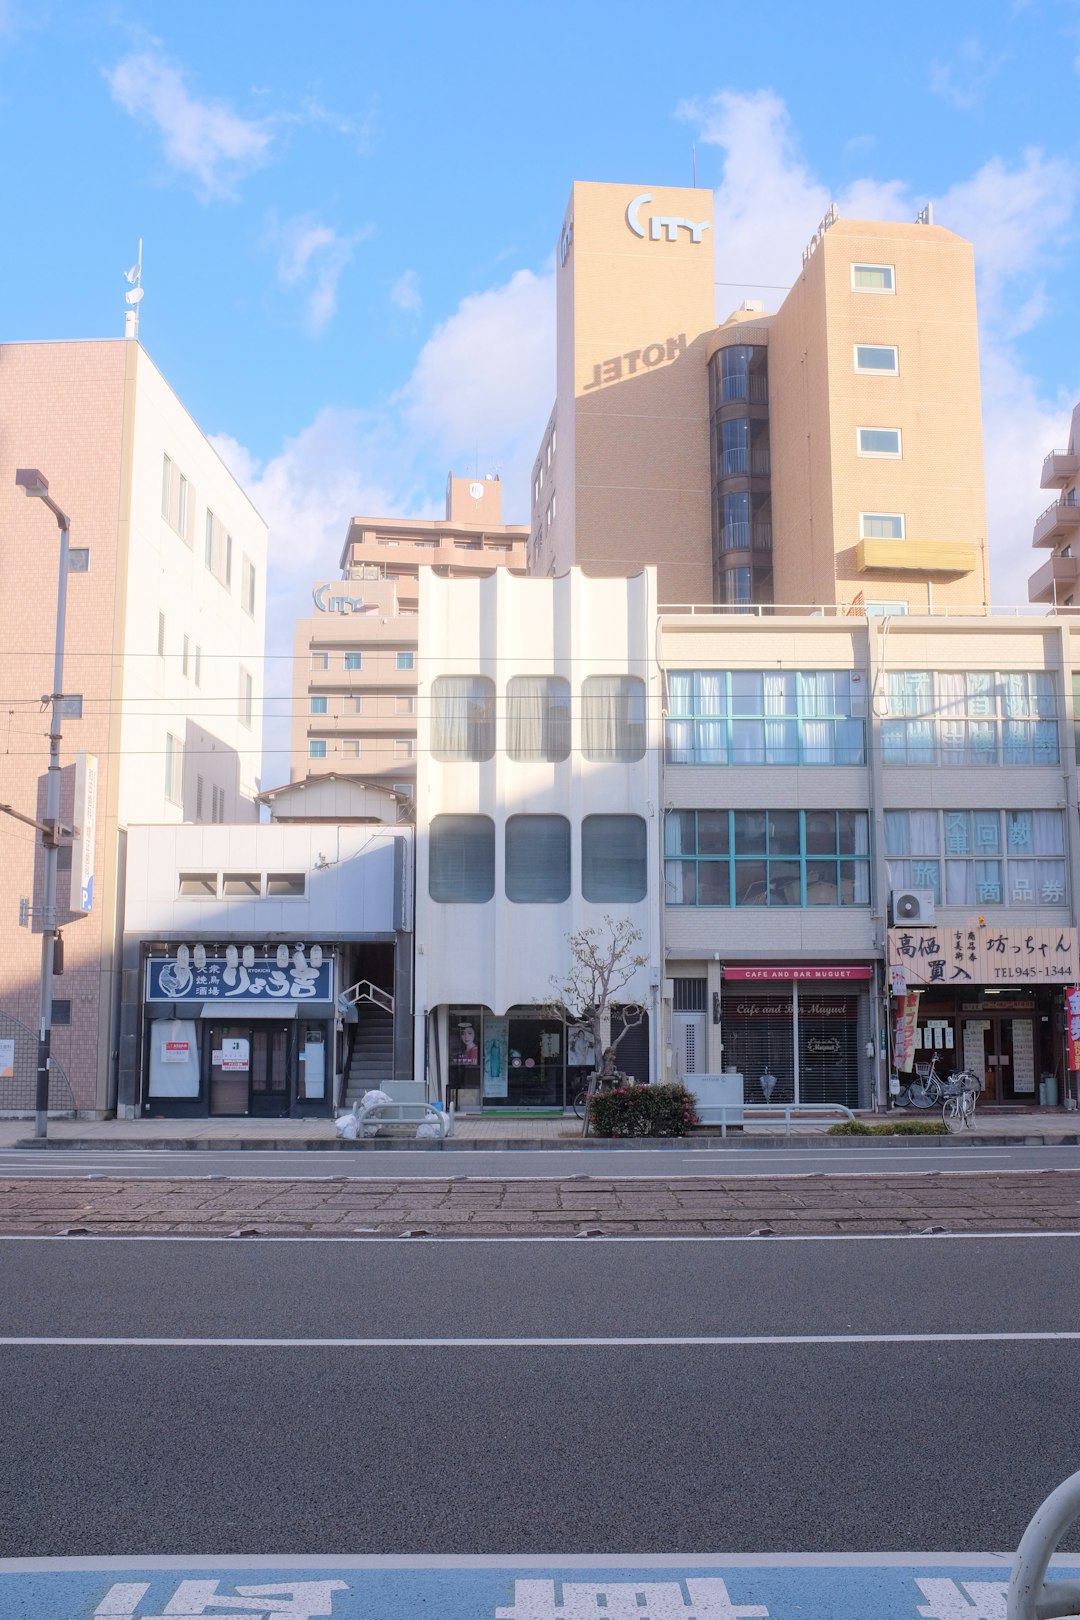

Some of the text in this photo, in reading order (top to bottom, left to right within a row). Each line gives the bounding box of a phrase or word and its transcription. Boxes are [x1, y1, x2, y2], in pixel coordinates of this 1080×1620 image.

[626, 193, 710, 243] CITY
[313, 583, 363, 613] CITY
[978, 878, 1065, 903] 商品券
[896, 933, 941, 958] 高価
[953, 930, 964, 961] 古美術
[986, 934, 1072, 958] 坊っちゃん
[223, 959, 320, 998] りょう吉
[928, 959, 972, 982] 買入
[196, 986, 221, 996] 酒場
[736, 1003, 760, 1016] Cafe
[762, 1003, 782, 1014] and
